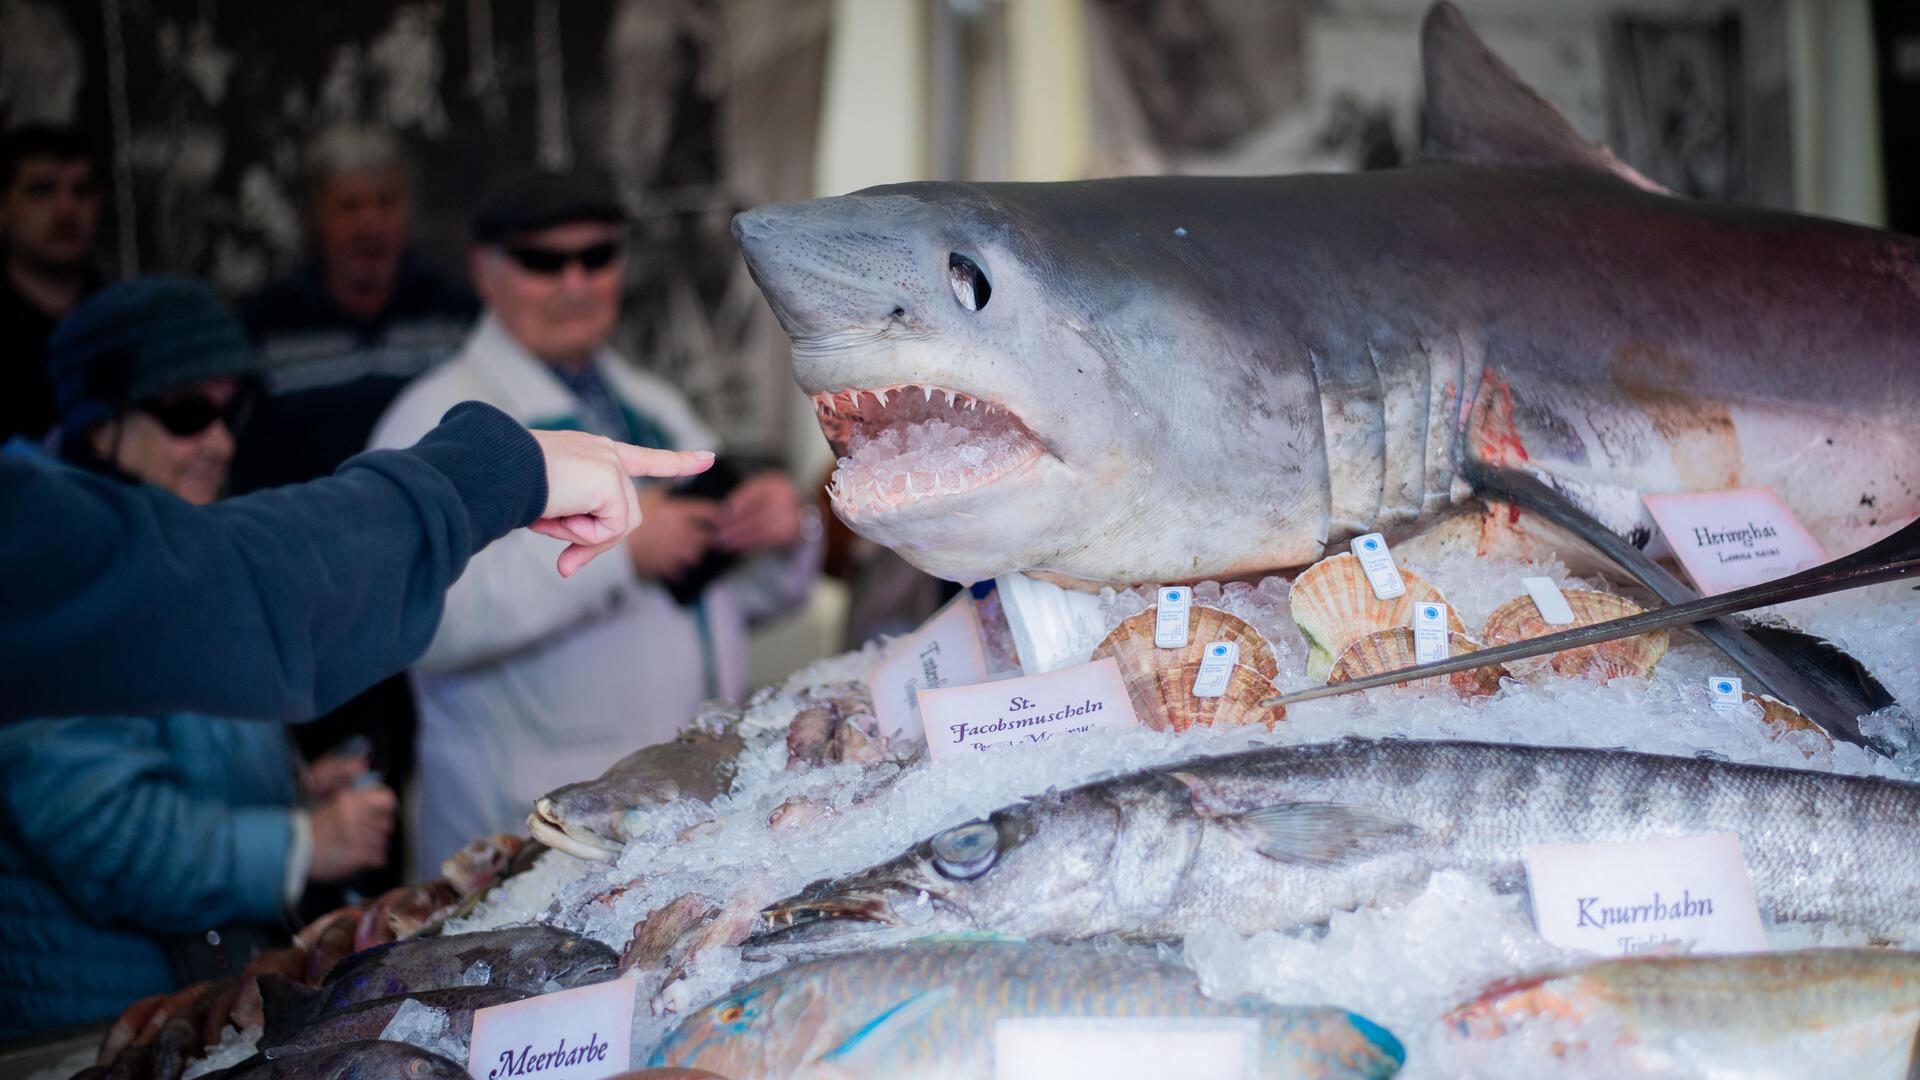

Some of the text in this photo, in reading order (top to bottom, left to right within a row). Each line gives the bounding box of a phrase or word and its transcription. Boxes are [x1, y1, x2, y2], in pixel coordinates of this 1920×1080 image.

[1693, 520, 1777, 548] Heringhai
[950, 700, 1103, 743] Jacobsmuscheln
[1009, 696, 1036, 712] St.
[1576, 890, 1713, 929] Knurrhahn
[488, 1033, 608, 1080] Meerbarbe
